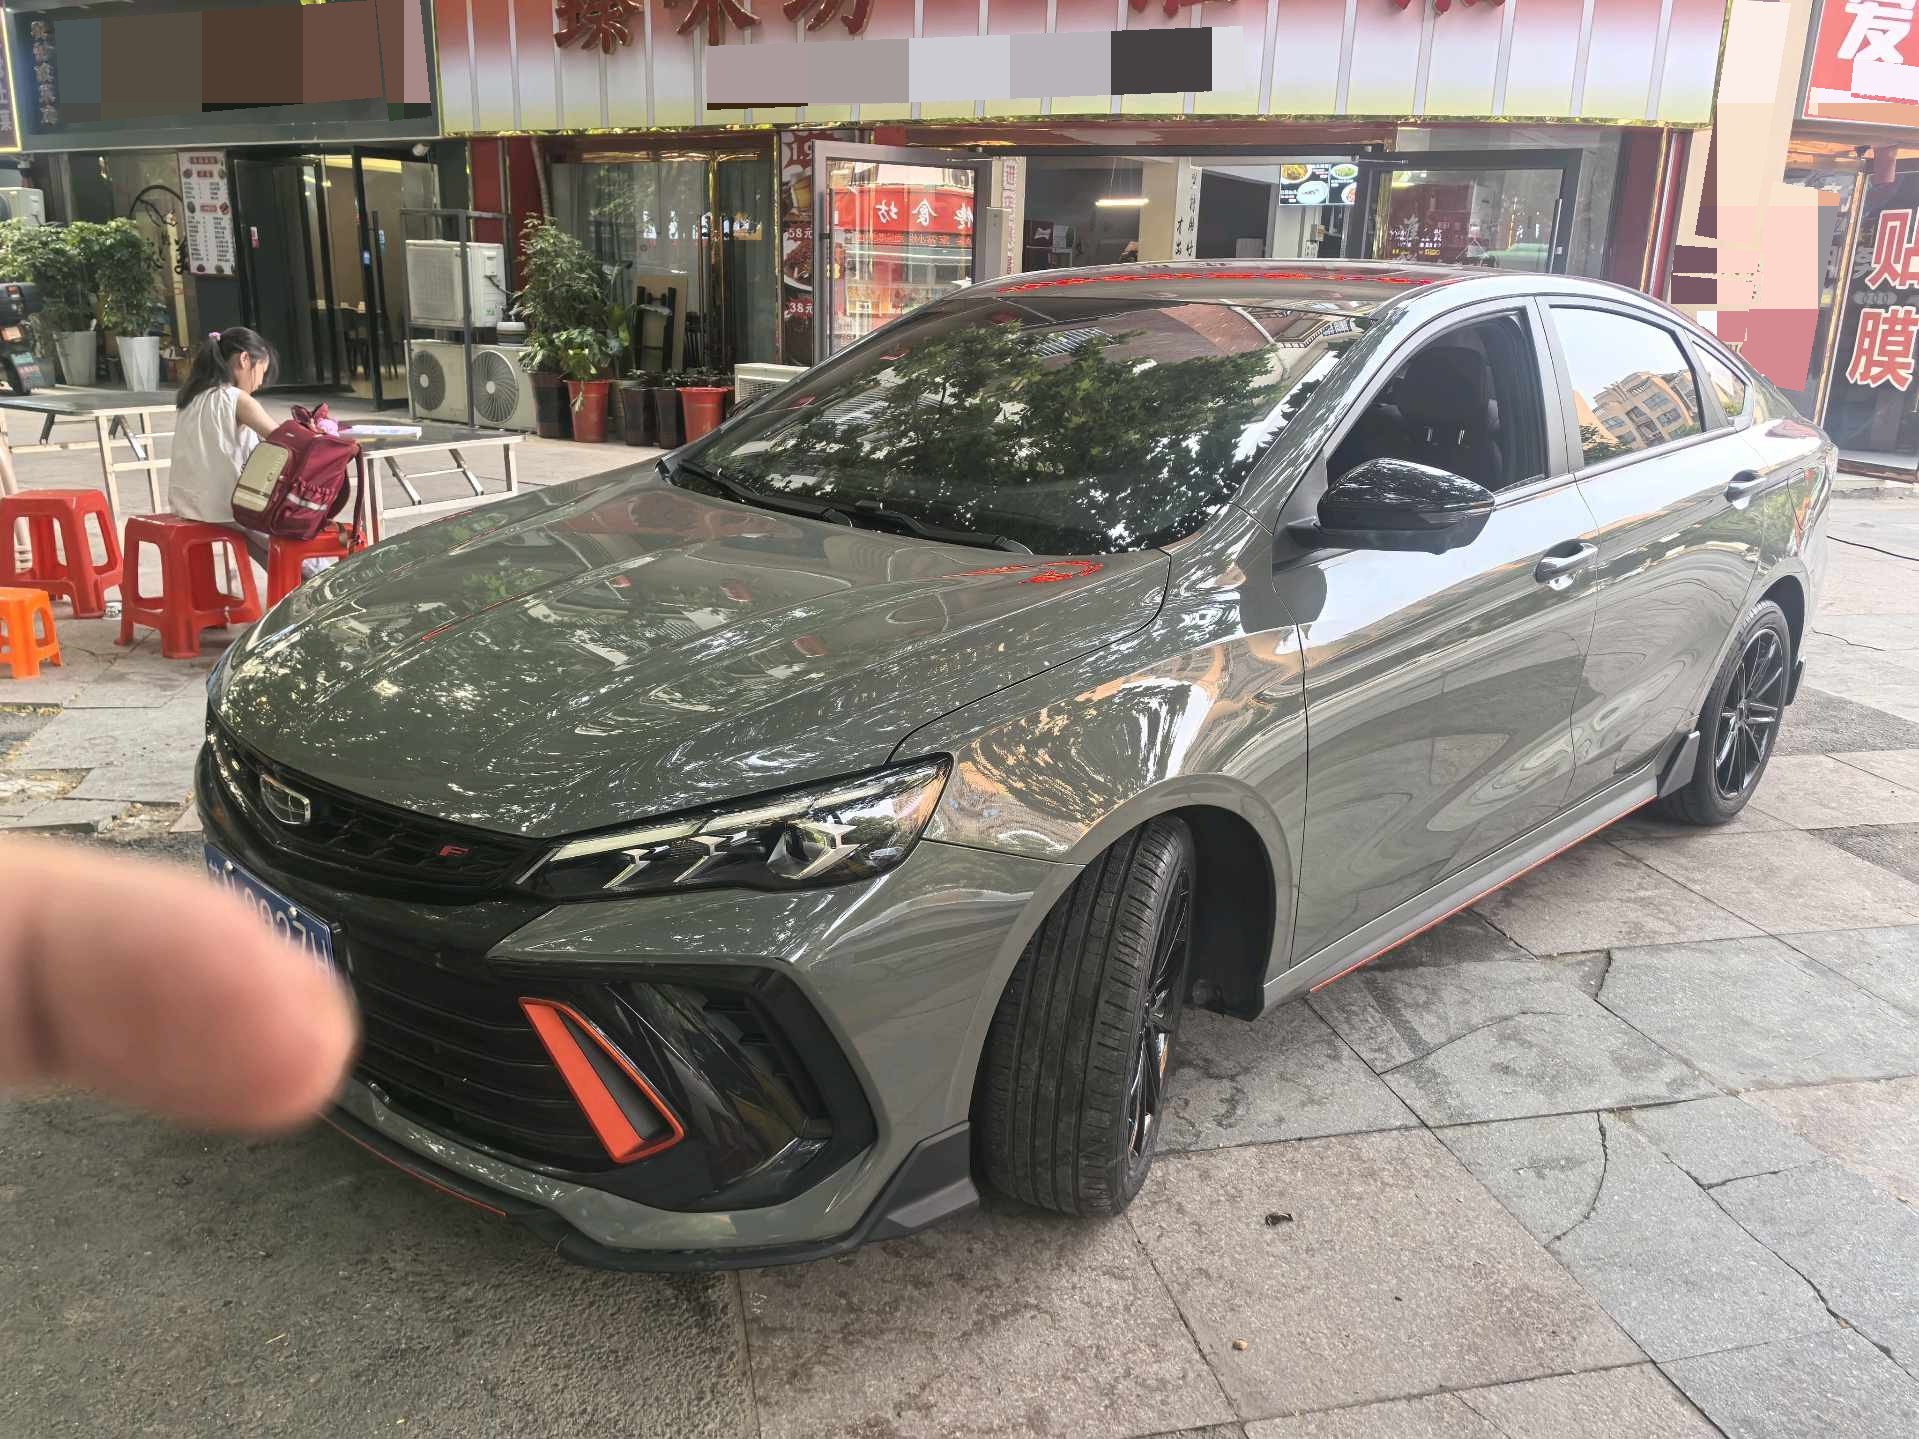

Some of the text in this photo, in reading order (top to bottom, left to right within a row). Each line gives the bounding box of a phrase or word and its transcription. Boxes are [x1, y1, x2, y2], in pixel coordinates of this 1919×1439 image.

[788, 227, 812, 239] 58元
[1846, 206, 1919, 391] 贴膜
[789, 302, 812, 313] 38元
